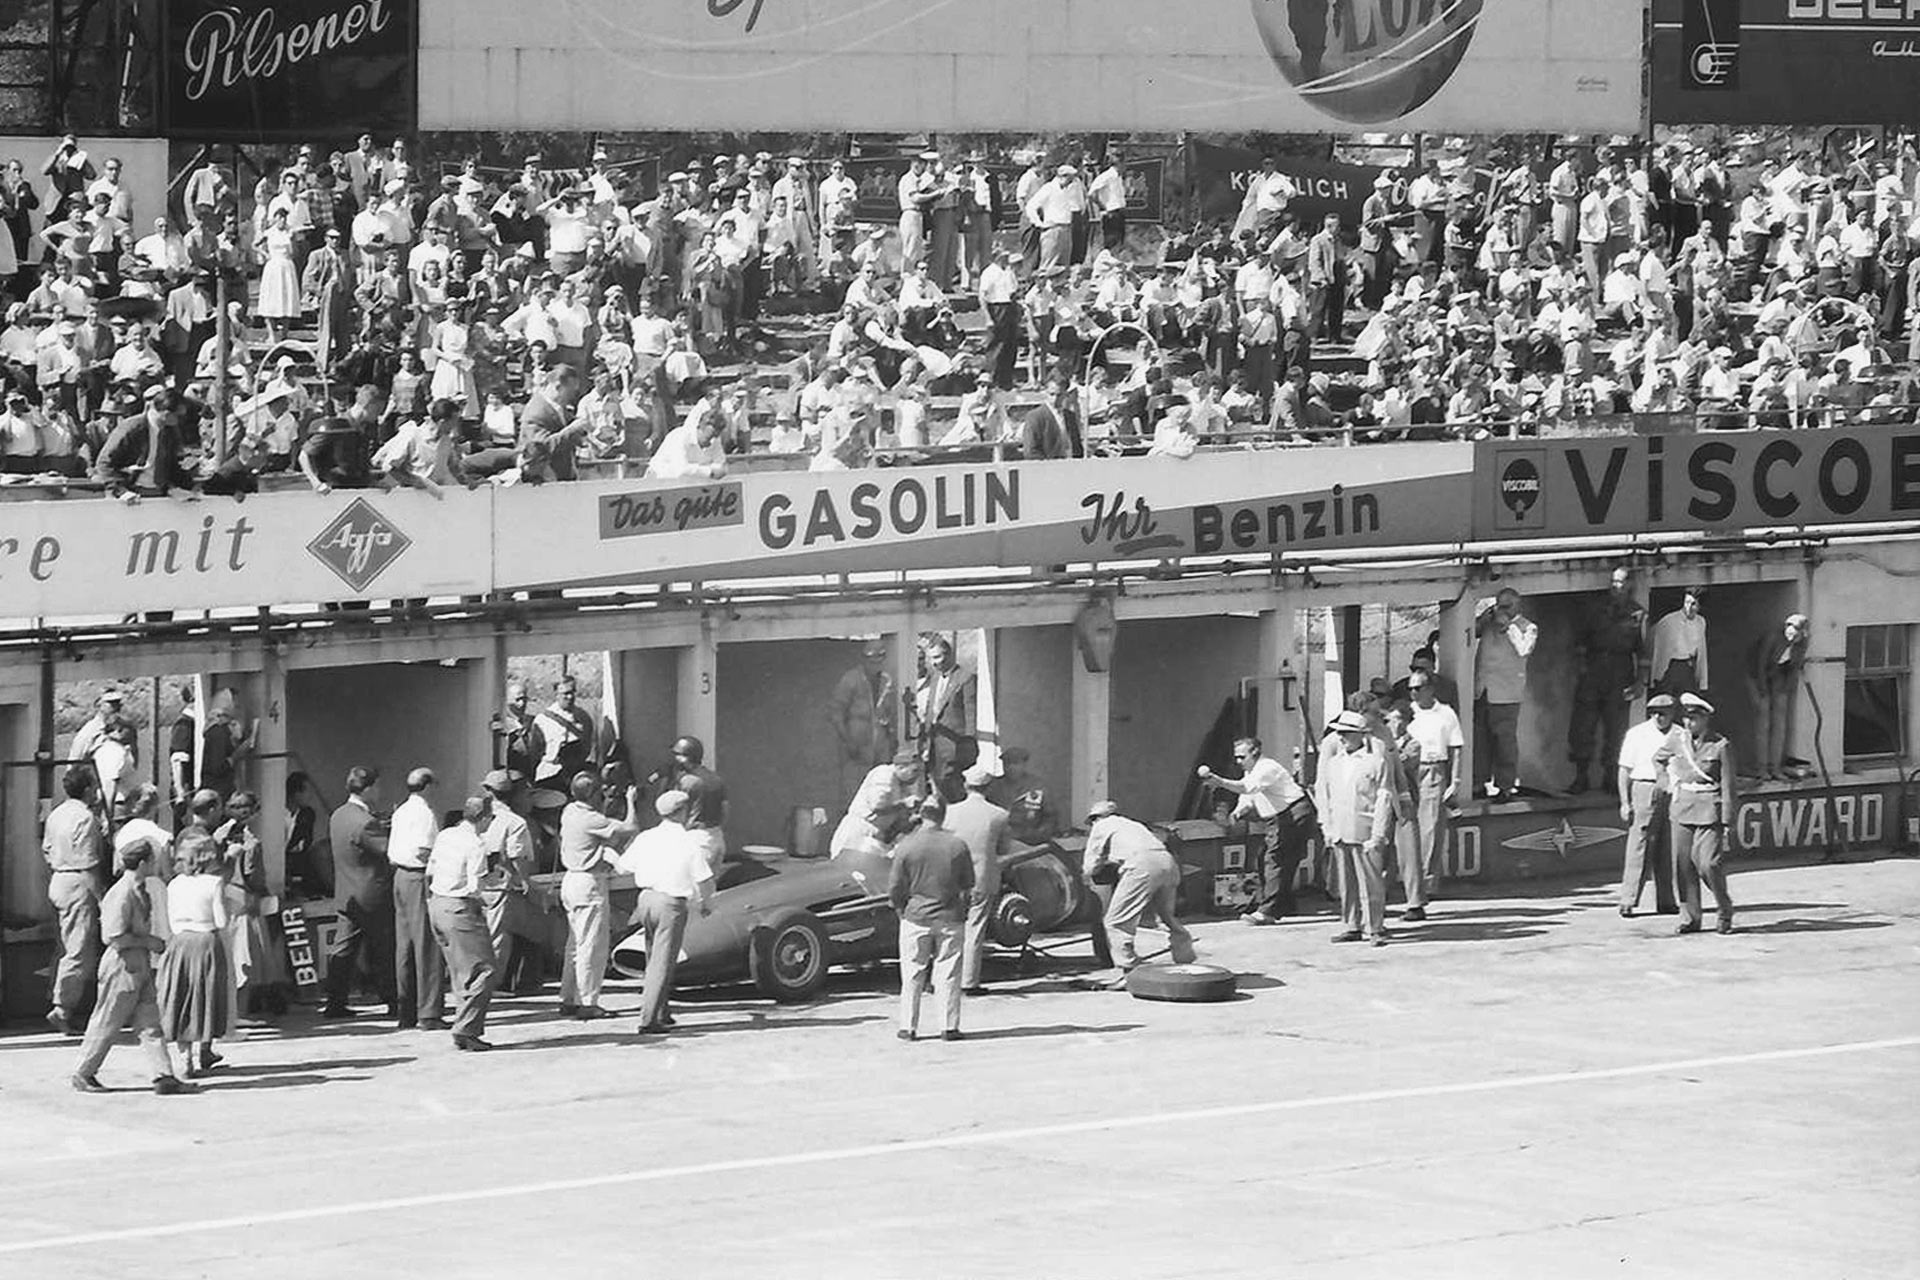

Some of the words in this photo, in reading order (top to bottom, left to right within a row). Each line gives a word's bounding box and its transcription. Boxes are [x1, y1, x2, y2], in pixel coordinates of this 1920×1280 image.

[184, 0, 391, 100] Pilsener
[126, 515, 254, 576] mit
[320, 521, 392, 574] Agfa
[609, 495, 665, 529] Das
[759, 469, 1020, 549] GASOLIN
[1081, 491, 1157, 544] Ihr
[1194, 483, 1380, 552] Benzin
[281, 906, 319, 986] BEHR
